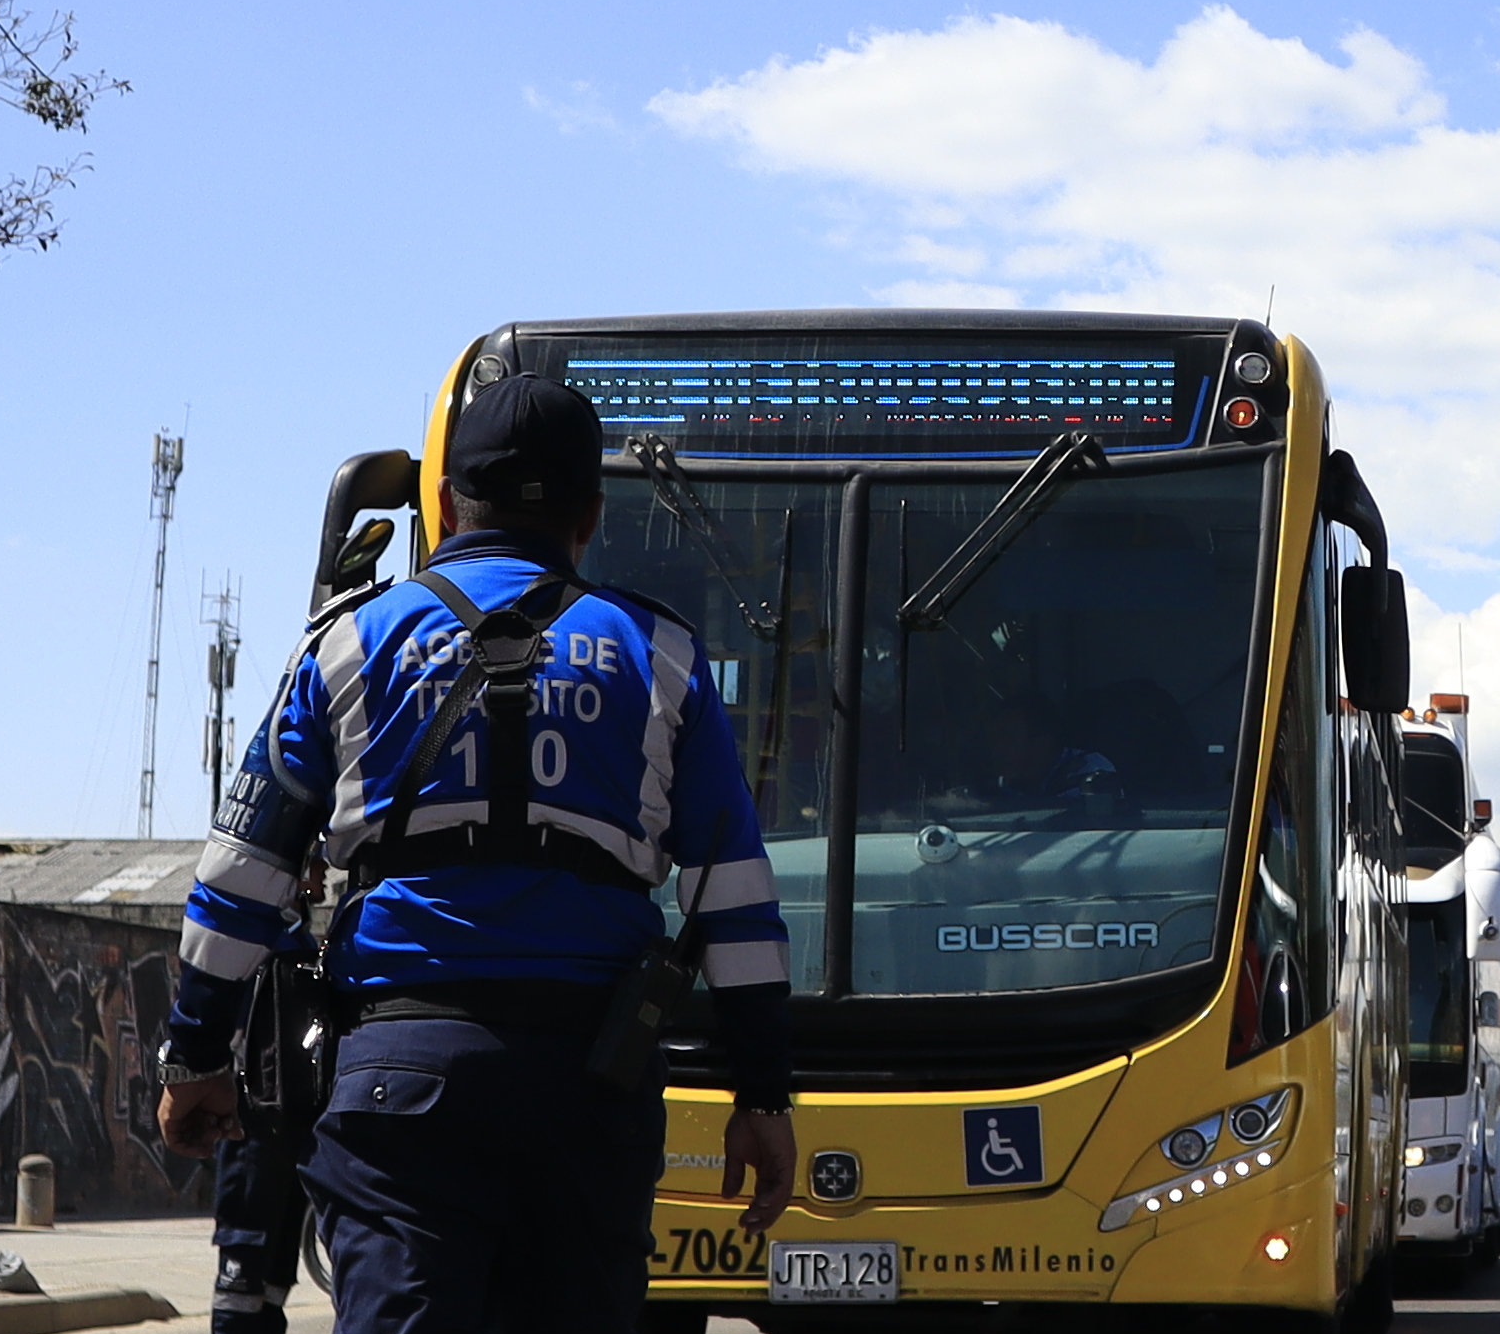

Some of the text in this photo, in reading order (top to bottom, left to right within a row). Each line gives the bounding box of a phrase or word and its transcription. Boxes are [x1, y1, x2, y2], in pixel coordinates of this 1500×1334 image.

[568, 632, 619, 674] DE
[450, 729, 567, 788] 10
[936, 921, 1160, 952] BUSSCAR
[902, 1245, 1116, 1273] TransMilenio
